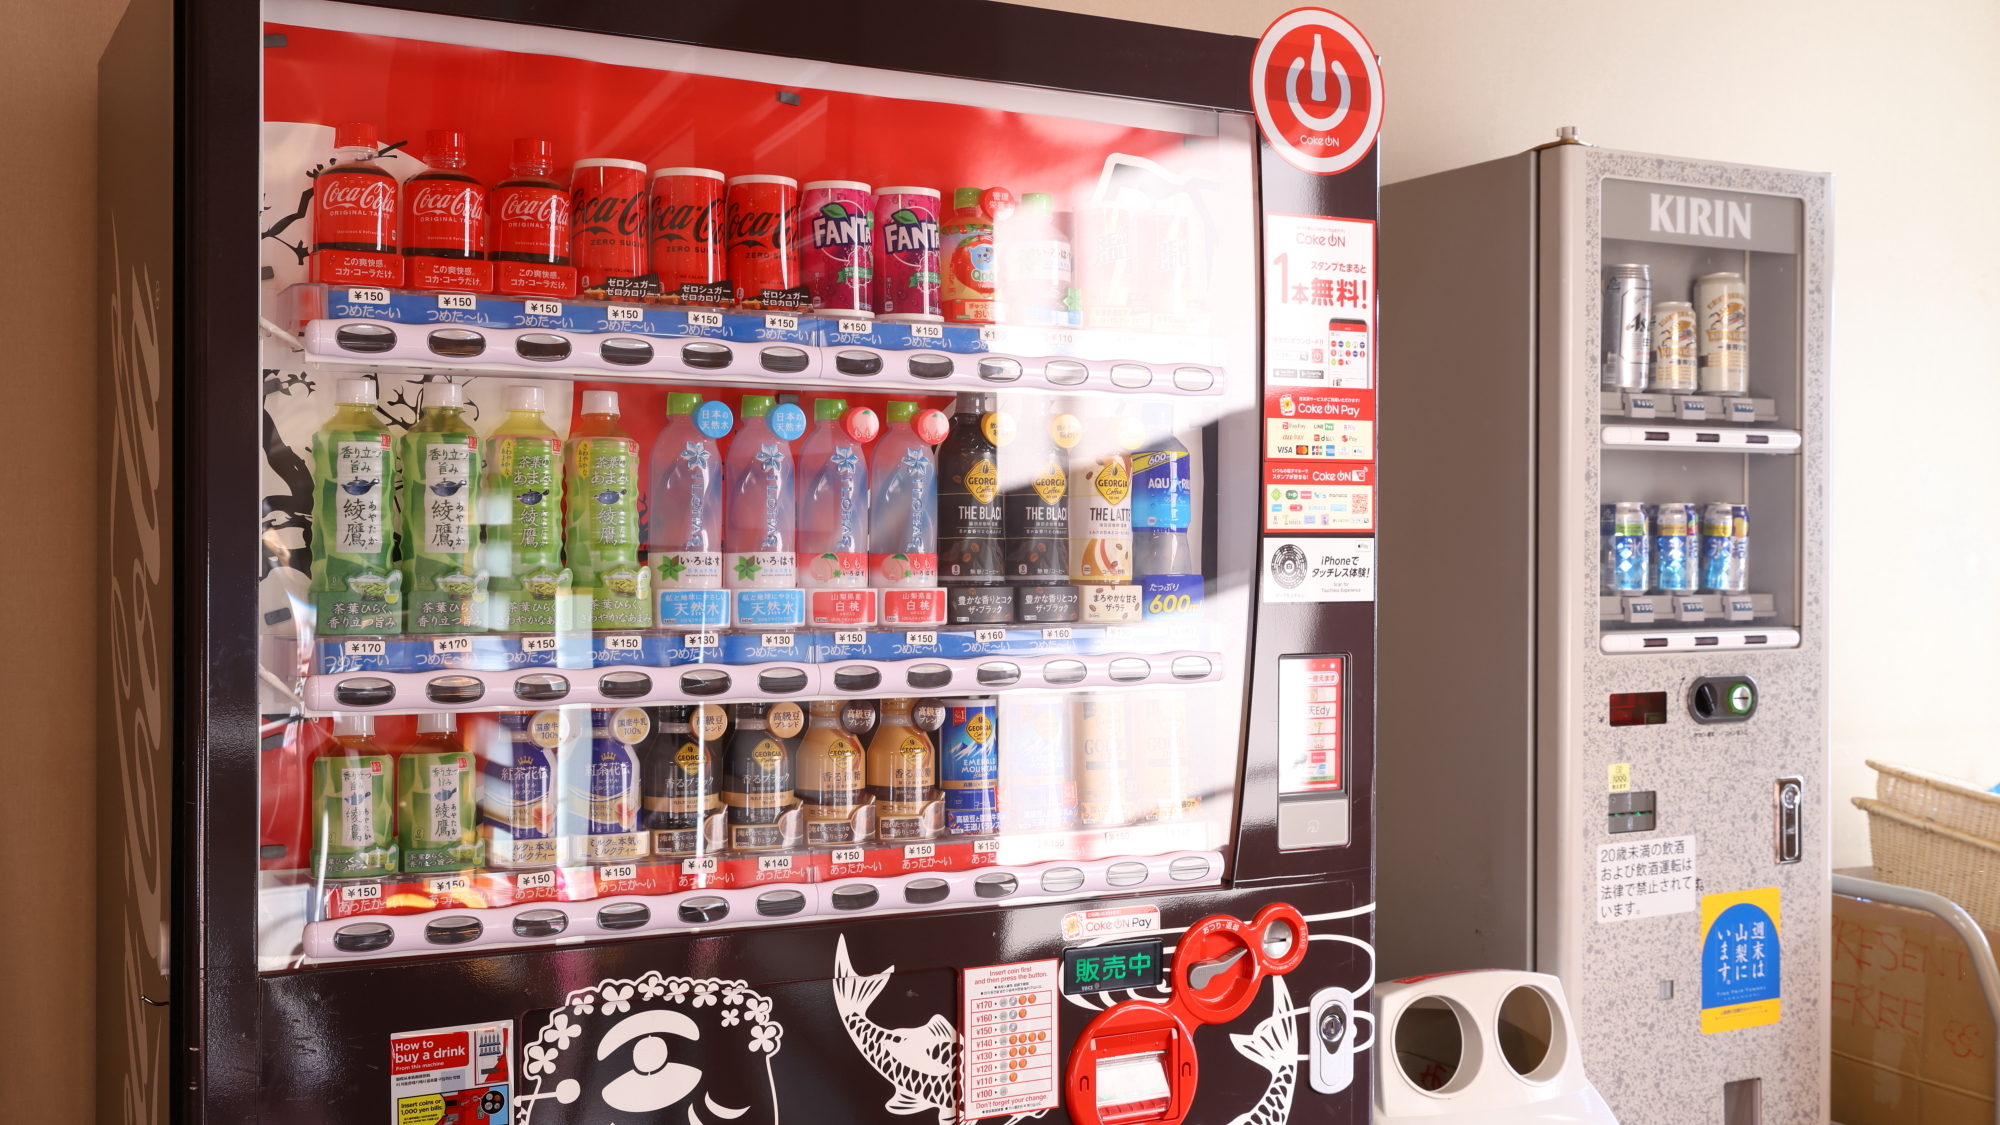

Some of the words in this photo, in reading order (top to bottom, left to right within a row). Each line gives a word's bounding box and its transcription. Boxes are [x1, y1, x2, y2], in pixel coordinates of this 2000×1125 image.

[1300, 135, 1324, 146] Coke
[322, 181, 396, 213] Coca-Cola
[413, 187, 484, 220] Coca-Cola
[501, 193, 570, 226] Coca-Cola
[369, 210, 391, 219] TATE
[1649, 192, 1752, 241] KIRIN
[813, 215, 872, 248] FANTA
[1296, 232, 1326, 246] Coke
[343, 257, 387, 269] この爽快感。
[1310, 261, 1367, 274] スタンプたまると
[607, 278, 657, 290] ゼロシュガー
[681, 284, 731, 295] ゼロシュガー
[354, 290, 384, 302] ¥150
[762, 290, 809, 300] ゼロシュガー
[443, 297, 472, 307] ¥150
[701, 409, 729, 420] 日本の
[1298, 403, 1323, 414] Coke
[1341, 404, 1361, 418] Pay
[775, 412, 803, 422] 日本の
[701, 420, 730, 430] 天然水
[340, 445, 382, 459] 香り立つ
[428, 448, 469, 462] 香り立つ
[1277, 446, 1293, 454] VISA
[350, 459, 371, 474] 旨み
[438, 461, 459, 475] 旨み
[519, 455, 551, 469] 茶葉の
[595, 455, 627, 470] 茶葉の
[513, 470, 552, 486] あまみ
[590, 470, 629, 486] あまみ
[1312, 471, 1336, 481] Coke
[1097, 479, 1129, 488] GEORGIA
[342, 498, 367, 548] 綾鷹
[368, 501, 378, 546] あやたか
[431, 499, 455, 548] 綾鷹
[843, 557, 861, 569] もも
[913, 557, 931, 569] もも
[1321, 556, 1359, 566] iPhoneで
[1312, 567, 1370, 579] タッチレス体験!
[1149, 583, 1179, 592] たっぷり
[665, 594, 727, 602] 私と地球にやさしい
[831, 593, 862, 601] 山梨県産
[902, 592, 933, 600] 山梨県産
[957, 595, 1012, 606] 豊かな香りとコク
[1024, 594, 1078, 605] 豊かな香りとコク
[1093, 594, 1137, 603] まろやかな甘さ
[332, 602, 394, 615] 茶葉ひらく、
[422, 601, 481, 615] 茶葉ひらく、
[589, 598, 643, 612] 茶葉ひらく、
[674, 602, 720, 616] 天然水
[751, 602, 796, 616] 天然水
[835, 601, 860, 612] 白桃
[906, 600, 930, 611] 白桃
[968, 604, 1003, 615] ザ・ブラック
[1105, 603, 1126, 612] ザ・ラテ
[327, 616, 397, 630] 香り立つ旨み
[416, 615, 484, 628] 香り立つ旨み
[578, 611, 652, 625] さわやかなあまみ
[765, 635, 791, 645] ¥130
[980, 630, 1004, 641] ¥160
[1047, 629, 1070, 639] ¥160
[351, 643, 381, 653] ¥170
[439, 638, 468, 650] ¥170
[773, 711, 800, 721] 高級豆
[846, 709, 872, 719] 高級豆
[918, 707, 943, 717] 高級豆
[618, 718, 647, 727] 国産牛乳
[623, 727, 642, 735] 100%
[1600, 840, 1685, 863] 20歳未満の飲酒
[764, 858, 789, 868] ¥140
[1601, 858, 1693, 882] および飲酒運転は
[1600, 876, 1693, 901] 法律で禁止されて
[1600, 901, 1641, 919] います。
[1086, 921, 1112, 931] Coke
[1132, 918, 1152, 928] Pay
[1735, 923, 1748, 981] 山梨に
[1751, 921, 1765, 979] 週末は
[1717, 929, 1732, 985] います。
[1075, 952, 1151, 983] 販売中
[974, 977, 986, 985] and
[1000, 975, 1017, 983] press
[1027, 972, 1048, 980] button.
[976, 1001, 993, 1009] ¥170
[1832, 981, 1922, 1036] FREE
[976, 1014, 993, 1022] ¥160
[976, 1027, 993, 1035] ¥150
[395, 1042, 420, 1052] How
[422, 1040, 434, 1049] to
[976, 1040, 993, 1048] ¥140
[395, 1052, 419, 1063] buy
[433, 1046, 466, 1058] drink
[976, 1052, 993, 1060] ¥130
[976, 1065, 993, 1073] ¥120
[976, 1077, 993, 1085] ¥110
[976, 1090, 993, 1098] ¥100
[976, 1101, 992, 1109] Don't
[993, 1099, 1010, 1108] forget
[1011, 1097, 1024, 1105] your
[1025, 1094, 1048, 1103] change.
[419, 1107, 430, 1115] yen
